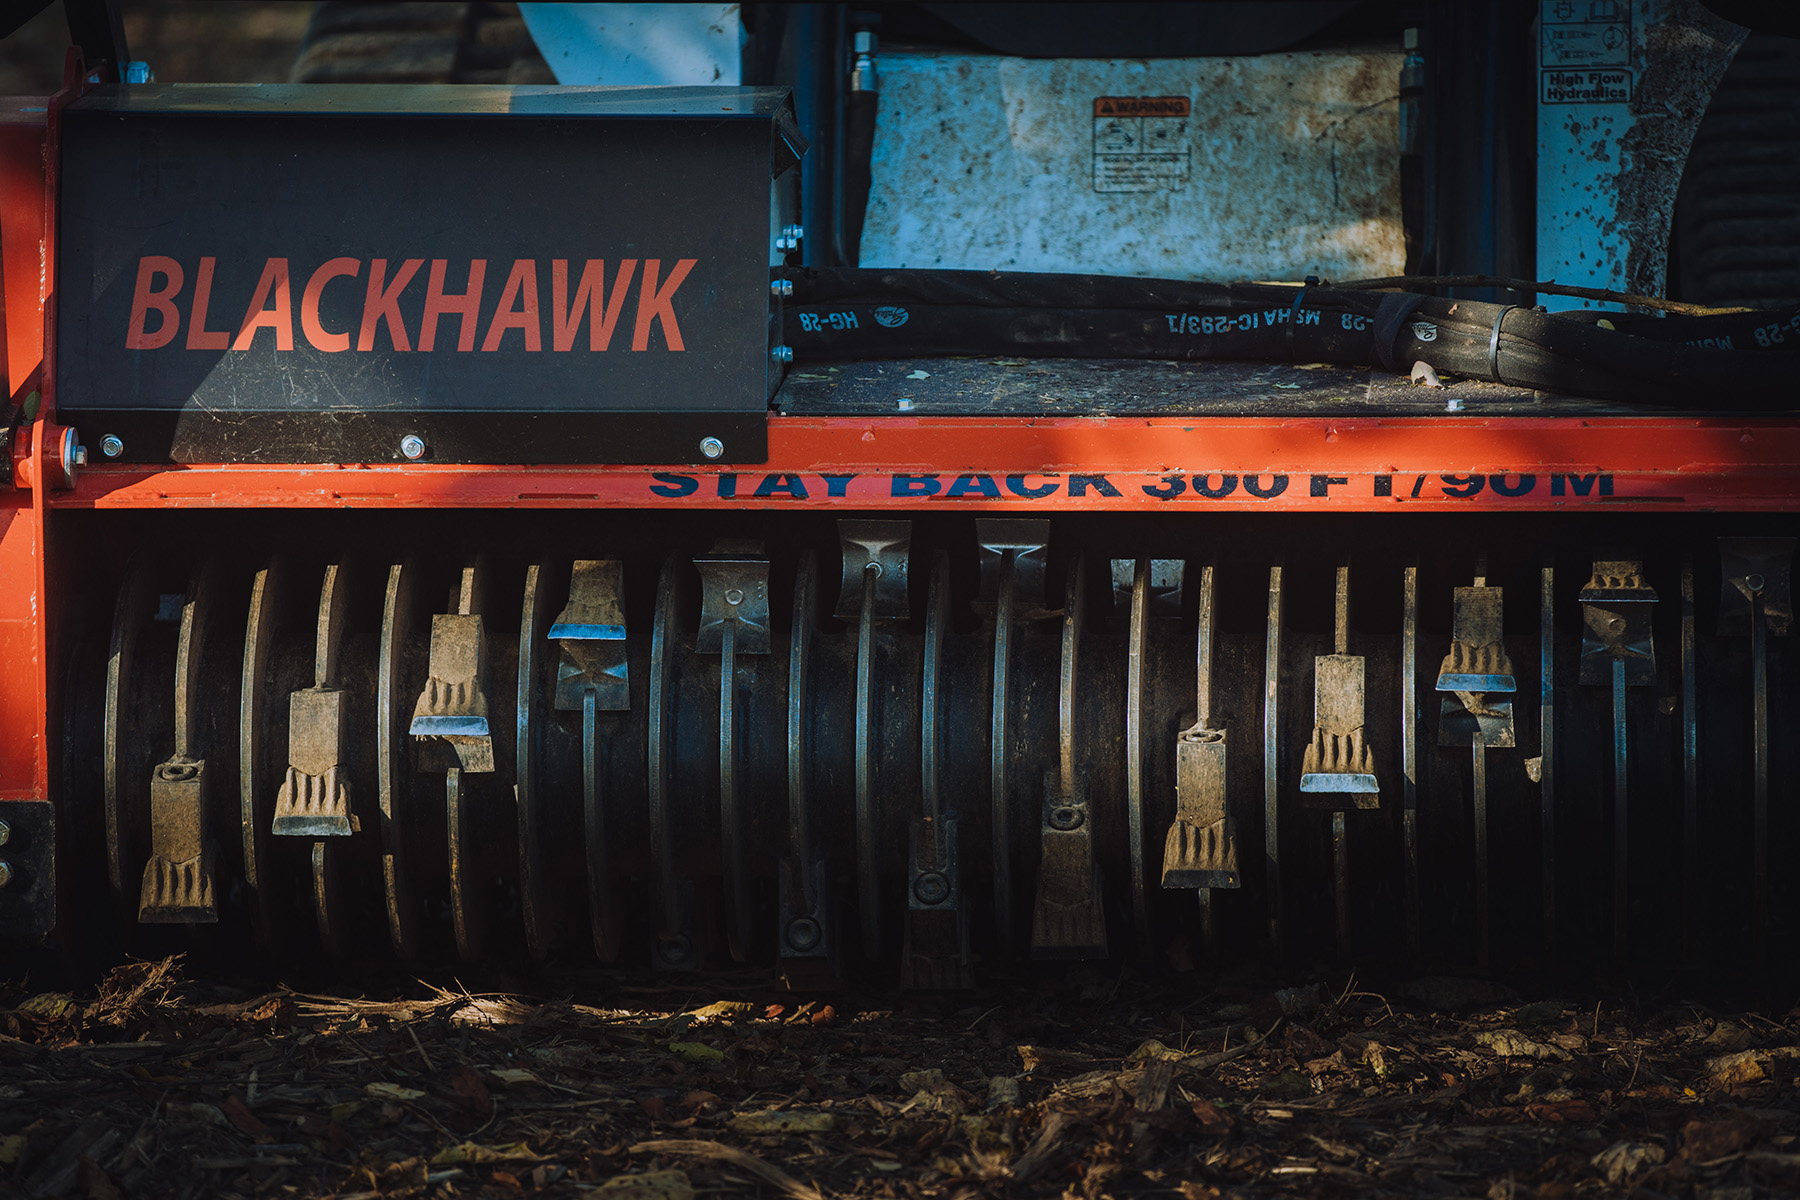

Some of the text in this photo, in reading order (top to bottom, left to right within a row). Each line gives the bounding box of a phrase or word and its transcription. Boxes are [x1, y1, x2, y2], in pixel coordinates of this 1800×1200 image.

[1550, 72, 1625, 86] High Flow
[1547, 86, 1627, 101] Hydraulics
[1116, 101, 1185, 113] WARNING
[125, 255, 699, 352] BLACKHAWK
[799, 311, 859, 332] HG-28
[891, 472, 1124, 499] BACK
[1141, 473, 1290, 499] 300
